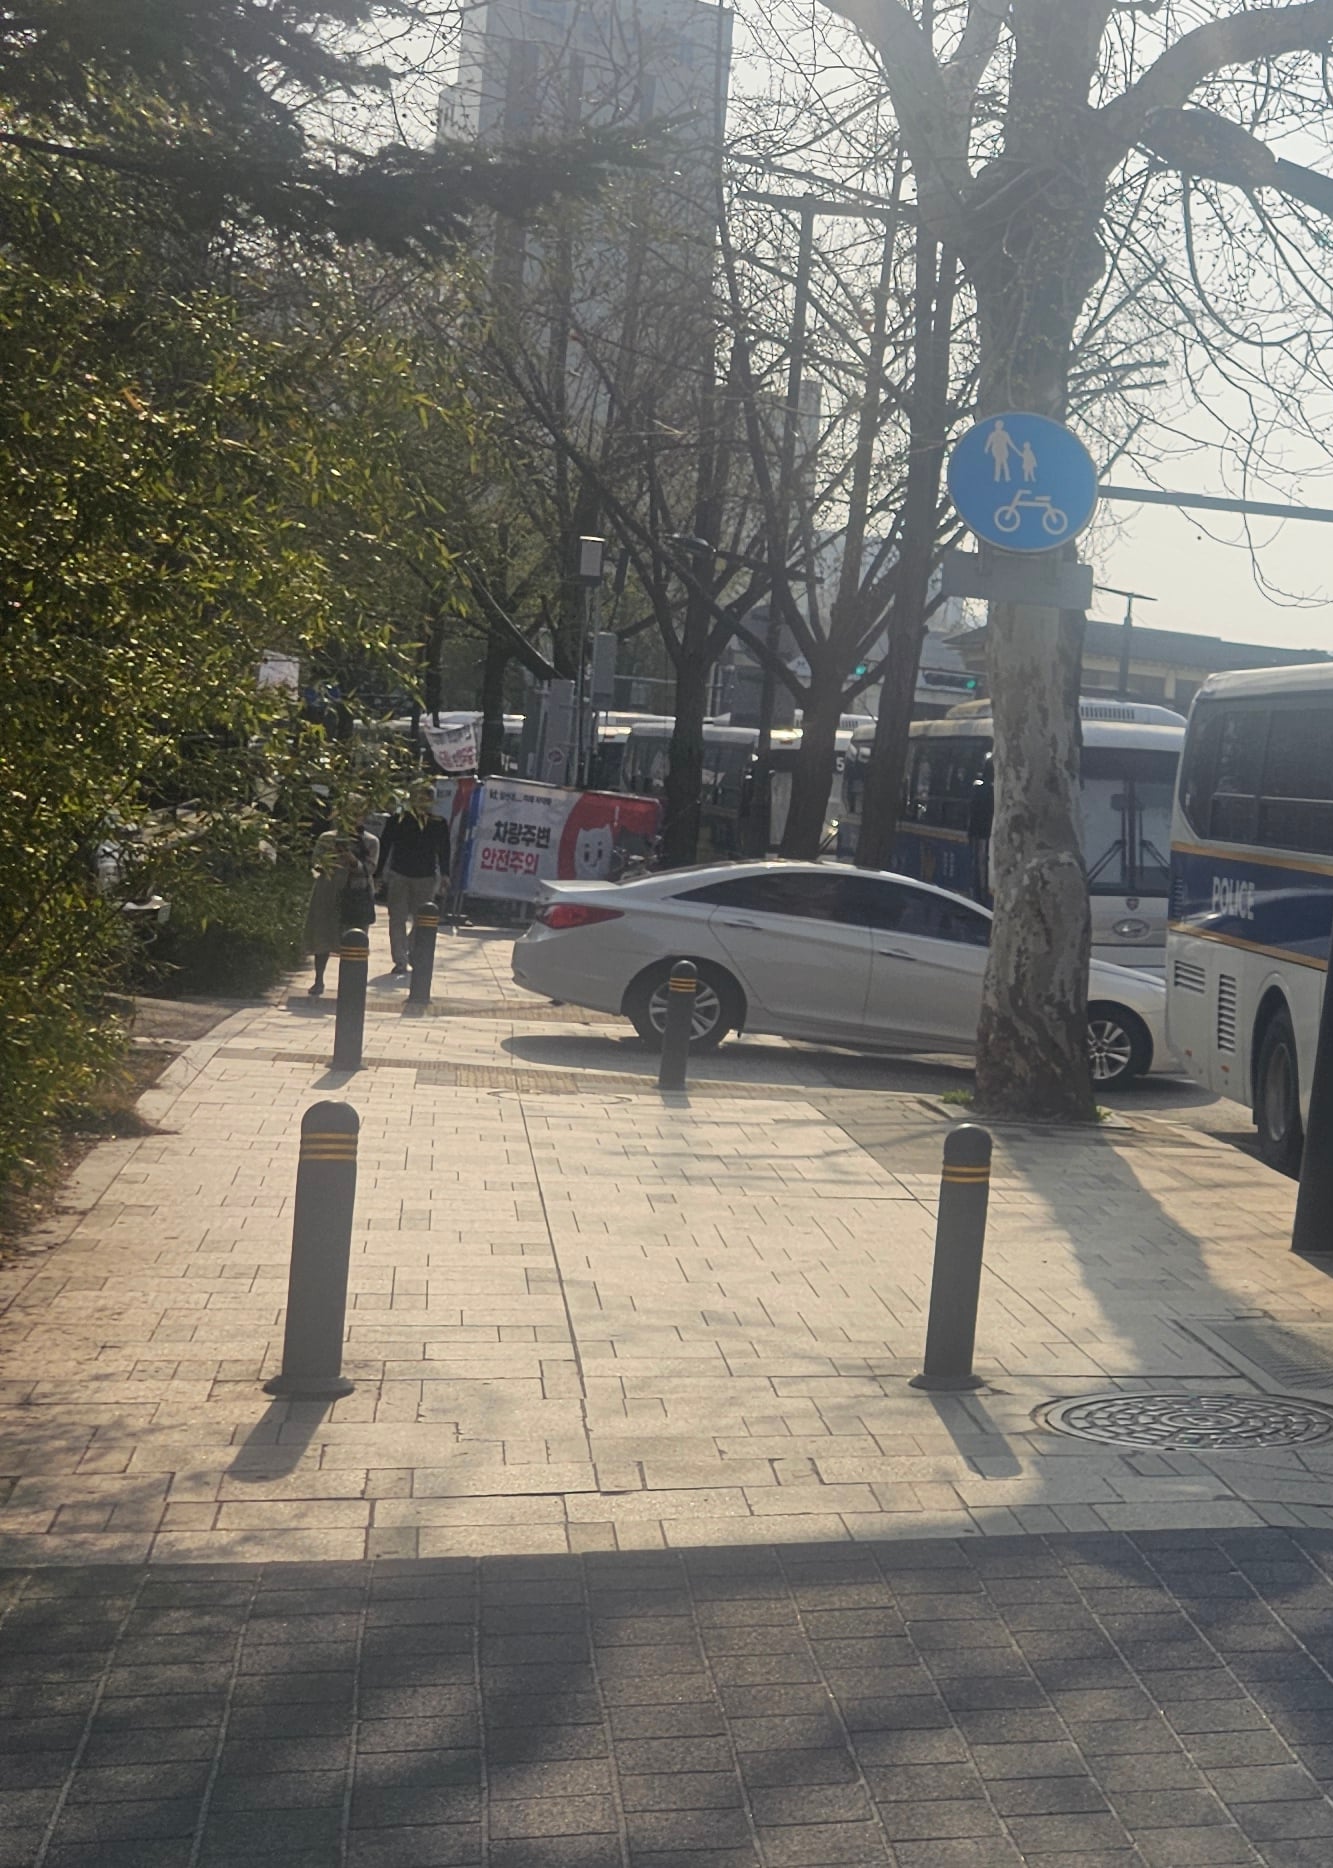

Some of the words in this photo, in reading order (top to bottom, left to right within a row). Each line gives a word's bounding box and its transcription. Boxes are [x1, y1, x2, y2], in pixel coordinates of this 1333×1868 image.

[493, 821, 552, 849] 차량주변
[480, 847, 540, 875] 안전주의
[1212, 876, 1255, 920] POLICE
